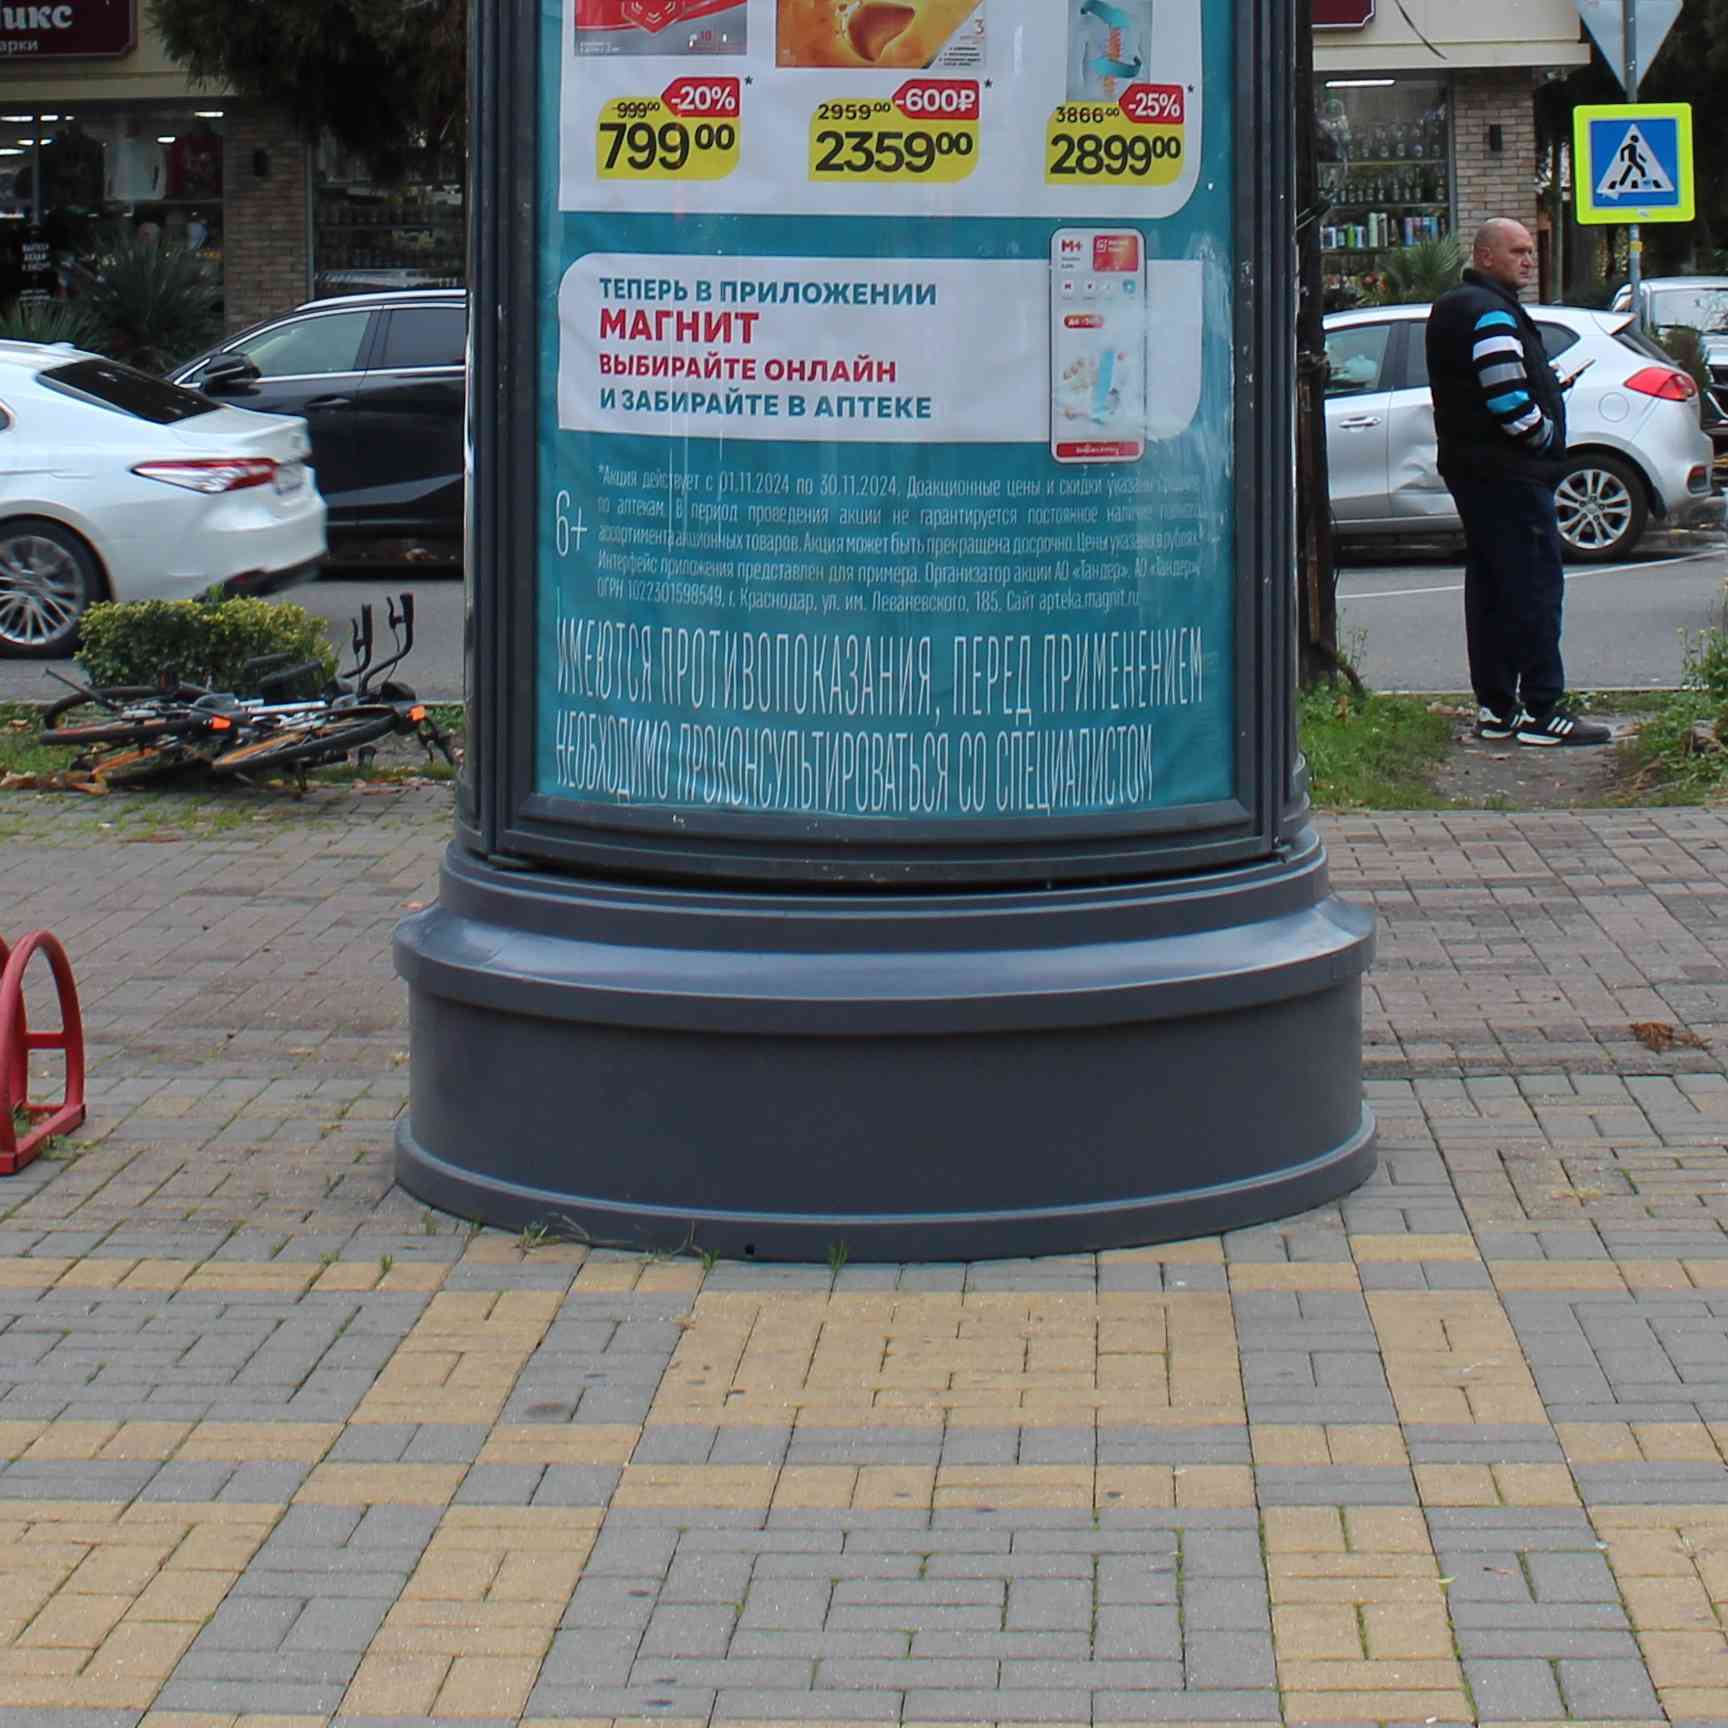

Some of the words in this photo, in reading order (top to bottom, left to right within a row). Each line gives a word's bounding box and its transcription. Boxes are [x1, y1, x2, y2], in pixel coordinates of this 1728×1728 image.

[671, 86, 736, 112] -20%
[1127, 93, 1181, 118] -25%
[599, 277, 688, 302] ТЕПЕРЬ
[696, 280, 713, 302] В
[720, 280, 938, 306] ПРИЛОЖЕНИИ
[599, 308, 760, 344] МАГНИТ
[599, 352, 757, 382] ВЫБИРАЙТЕ
[764, 354, 897, 383] ОНЛАЙН
[600, 388, 616, 409] И
[622, 388, 779, 417] ЗАБИРАЙТЕ
[788, 395, 807, 417] В
[815, 395, 932, 419] АПТЕКЕ
[705, 474, 713, 491] с
[720, 471, 789, 495] 01.11.2024
[796, 477, 814, 496] по
[906, 475, 1001, 499] Доакционные
[1007, 479, 1041, 498] цены
[1046, 479, 1055, 495] и
[1059, 479, 1103, 496] скидки
[556, 489, 588, 557] 6+
[691, 502, 738, 524] период
[748, 503, 829, 526] проведения
[839, 507, 881, 525] акции
[892, 508, 910, 524] не
[920, 507, 1017, 530] гарантируется
[1027, 505, 1098, 524] постоянное
[803, 531, 844, 555] Акция
[846, 536, 889, 554] может
[890, 531, 923, 555] быть
[926, 535, 1010, 558] прекращена
[737, 561, 823, 584] представлен
[828, 565, 855, 584] для
[857, 565, 921, 587] примера.
[925, 561, 1011, 588] Организатор
[1014, 564, 1053, 584] акции
[739, 585, 818, 615] Краснодар,
[556, 617, 652, 704] ИМЕЮТСЯ
[662, 626, 941, 727] ПРОТИВОПОКАЗАНИЯ,
[953, 635, 1032, 727] ПЕРЕД
[1043, 626, 1203, 713] ПРИМЕНЕНИЕМ
[556, 709, 671, 801] НЕОБХОДИМО
[678, 722, 949, 813] ПРОКОНСУЛЬТИРОВАТЬСЯ
[959, 731, 987, 812] СО
[996, 723, 1153, 817] СПЕЦИАЛИСТОМ
